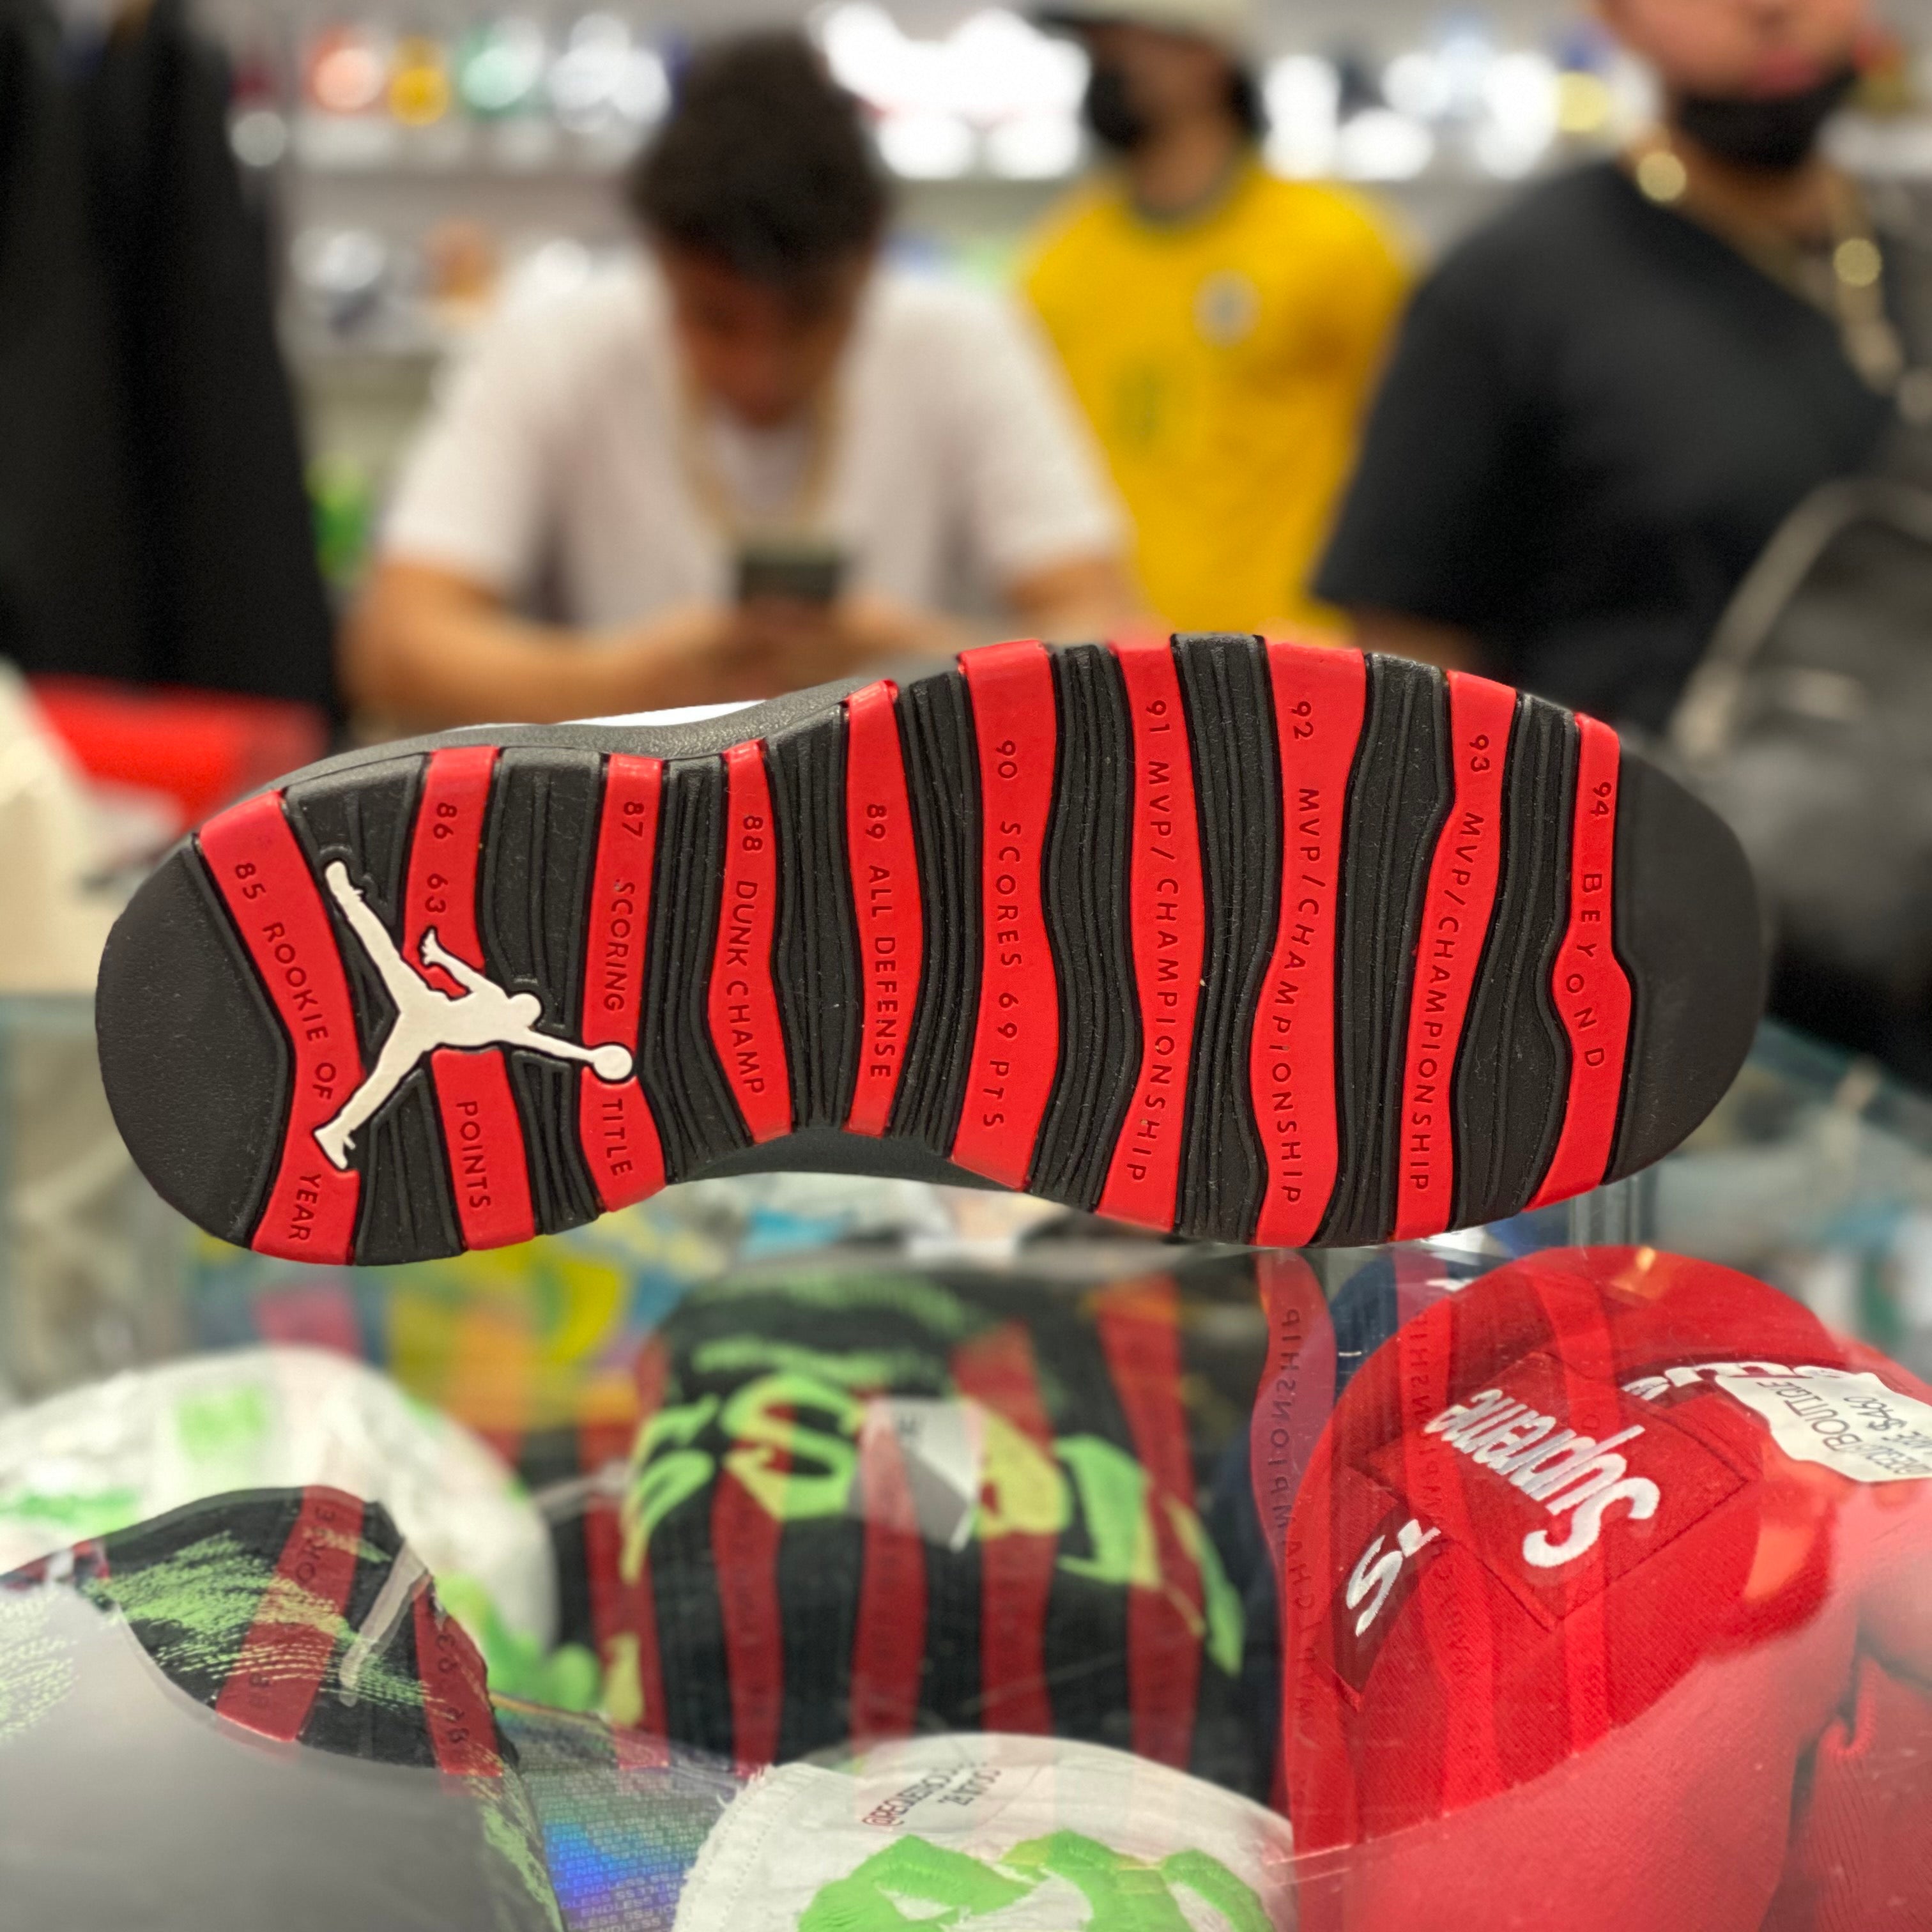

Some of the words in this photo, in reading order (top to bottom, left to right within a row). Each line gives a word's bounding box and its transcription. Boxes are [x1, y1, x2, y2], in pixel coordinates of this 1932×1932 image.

[1144, 698, 1169, 735] 91
[1292, 700, 1314, 741] 92
[995, 740, 1019, 780] 90
[1468, 733, 1491, 772] 93
[432, 801, 459, 840] 86
[620, 801, 646, 838] 87
[864, 804, 888, 841] 89
[1589, 781, 1613, 818] 94
[741, 815, 765, 853] 88
[234, 862, 266, 902] 85
[425, 873, 449, 915] 63
[868, 863, 894, 919] ALL
[995, 819, 1023, 967] SCORES
[602, 878, 636, 1013] SCORING
[723, 880, 759, 967] DUNK
[262, 921, 330, 1043] ROOKIE
[1565, 873, 1605, 1069] BEYOND
[869, 937, 898, 1080] DEFENSE
[997, 991, 1019, 1040] 69
[724, 980, 766, 1096] CHAMP
[311, 1062, 338, 1101] OF
[980, 1060, 1010, 1129] PTS
[455, 1100, 492, 1210] POINTS
[601, 1098, 634, 1176] TITLE
[287, 1173, 323, 1242] YEAR
[1425, 1389, 1660, 1568] Supreme
